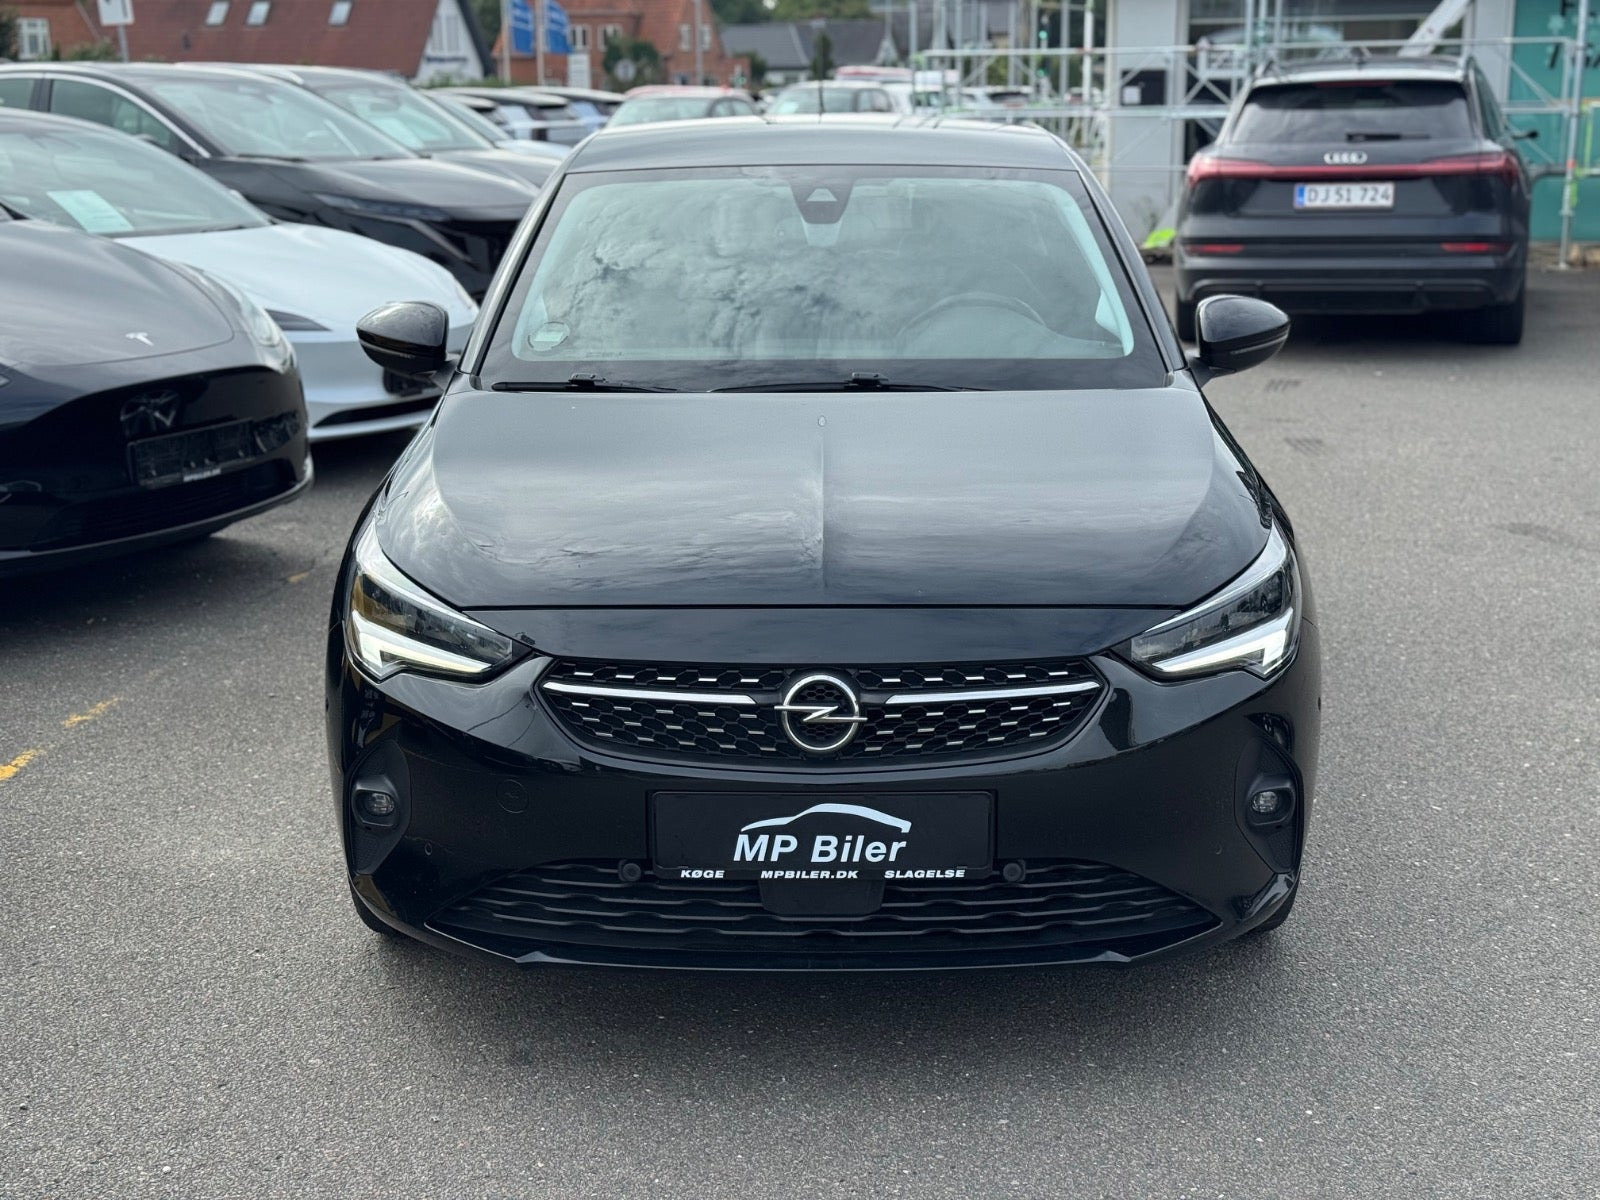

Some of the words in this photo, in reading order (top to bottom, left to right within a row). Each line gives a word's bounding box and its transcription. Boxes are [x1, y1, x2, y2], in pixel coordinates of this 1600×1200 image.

[1360, 186, 1391, 202] 724
[733, 833, 798, 862] MP
[810, 834, 907, 863] Biler
[680, 869, 725, 879] KØGE
[760, 869, 859, 879] MPBILER.DK
[884, 868, 966, 879] SLAGELSE
